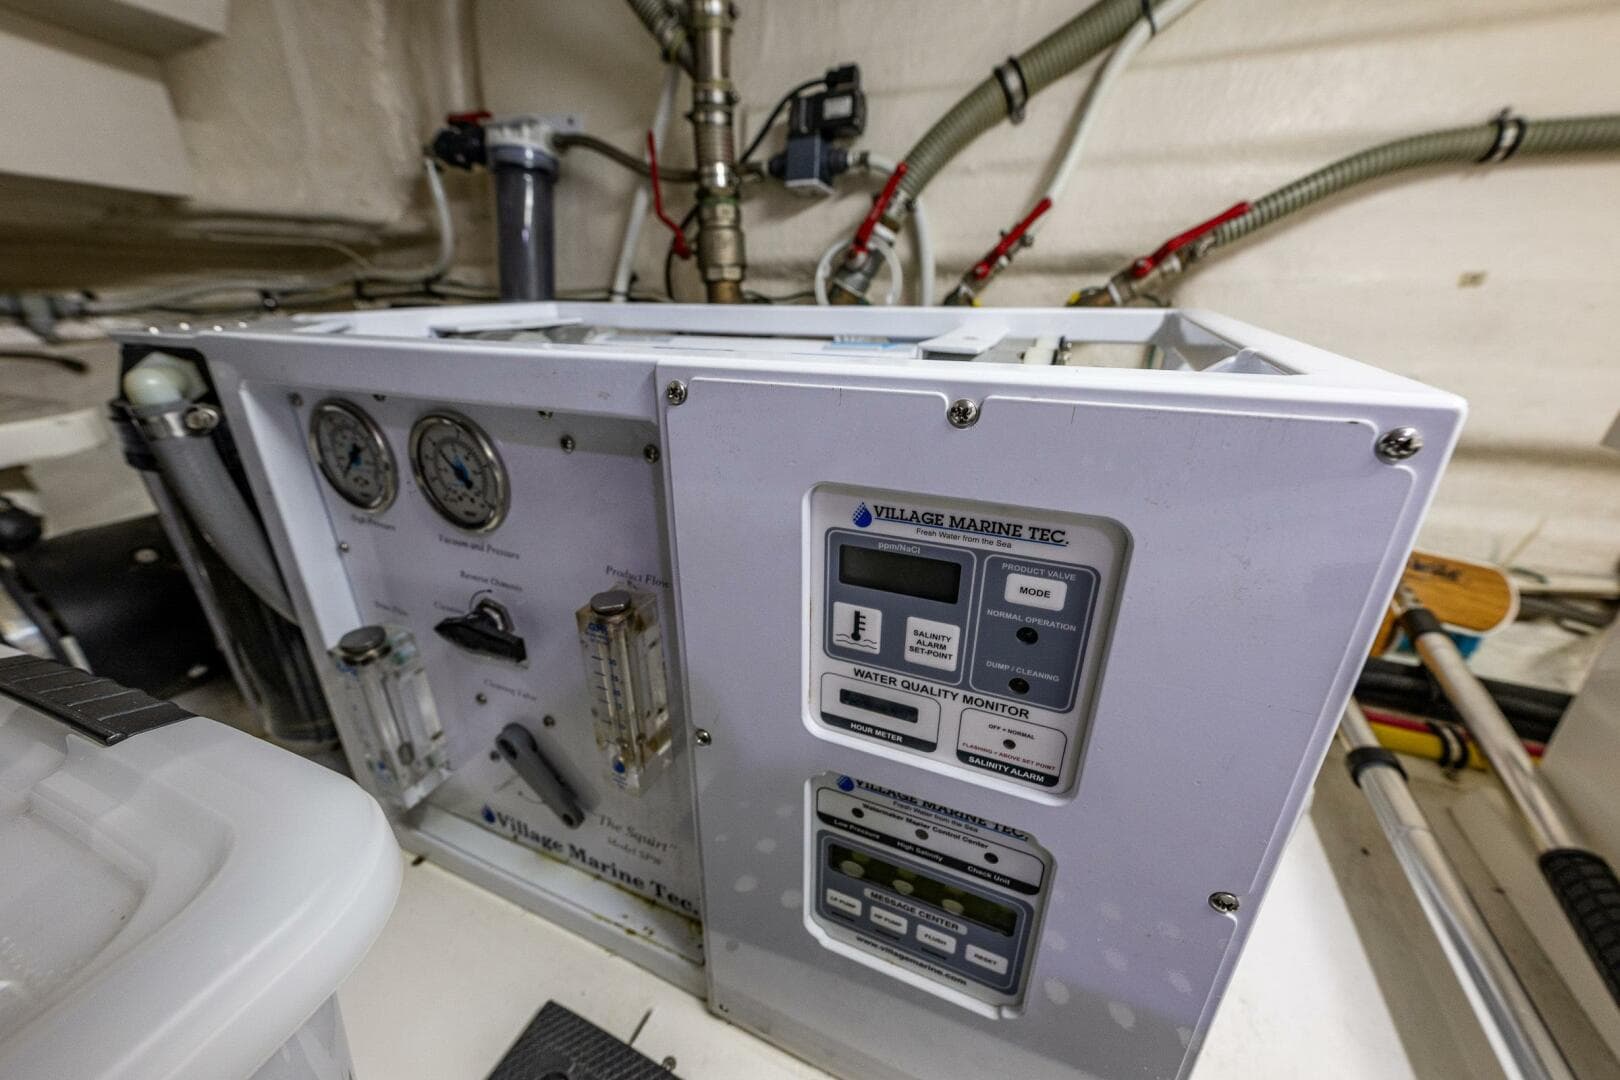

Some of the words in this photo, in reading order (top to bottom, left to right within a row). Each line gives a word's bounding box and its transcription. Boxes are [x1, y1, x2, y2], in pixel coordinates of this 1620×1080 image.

[873, 505, 944, 526] VILLAGE
[948, 515, 1022, 538] MARINE
[1029, 526, 1070, 545] TEC.
[878, 541, 921, 555] ppm/NaCl
[916, 528, 937, 538] Fresh
[938, 531, 960, 541] Water
[962, 535, 981, 544] from
[981, 538, 995, 546] the
[996, 539, 1012, 549] Sea
[605, 564, 643, 583] Product
[645, 574, 671, 590] Flow
[1001, 562, 1046, 577] PRODUCT
[1047, 569, 1078, 582] VALVE
[1019, 586, 1052, 599] MODE
[986, 608, 1024, 623] NORMAL
[1024, 615, 1077, 632] OPERATION
[913, 629, 953, 643] SALINITY
[916, 639, 948, 652] ALARM
[908, 645, 954, 661] SET-POINT
[985, 660, 1011, 672] DUMP
[1015, 667, 1060, 683] CLEANING
[853, 667, 898, 687] WATER
[900, 679, 959, 702] QUALITY
[962, 695, 1030, 720] MONITOR
[850, 722, 874, 736] HOUR
[874, 728, 903, 744] METER
[988, 723, 1001, 731] OFF
[1007, 728, 1036, 740] NORMAL
[962, 741, 993, 755] FLASHING
[999, 752, 1021, 762] ABOVE
[1021, 757, 1035, 766] SET
[1035, 761, 1057, 772] POINT
[968, 755, 1009, 773] SALINITY
[1010, 766, 1045, 783] ALARM
[600, 814, 623, 833] The
[862, 803, 905, 820] Watermaker
[905, 817, 931, 830] Master
[932, 826, 961, 840] Control
[961, 835, 990, 850] Center
[893, 800, 912, 811] Fresh
[913, 806, 934, 818] Water
[934, 814, 950, 825] from
[951, 819, 963, 828] the
[963, 823, 979, 833] Sea
[849, 824, 881, 840] Pressure
[896, 840, 914, 856] High
[914, 845, 944, 864] Salinity
[497, 811, 564, 851] Village
[567, 842, 645, 890] Marine
[649, 879, 700, 916] Tec.
[967, 864, 992, 879] Check
[993, 871, 1011, 886] Unit
[870, 891, 917, 914] MESSAGE
[918, 911, 960, 931] CENTER
[855, 936, 968, 987] www.villagemarine.com
[974, 953, 998, 966] RESET
